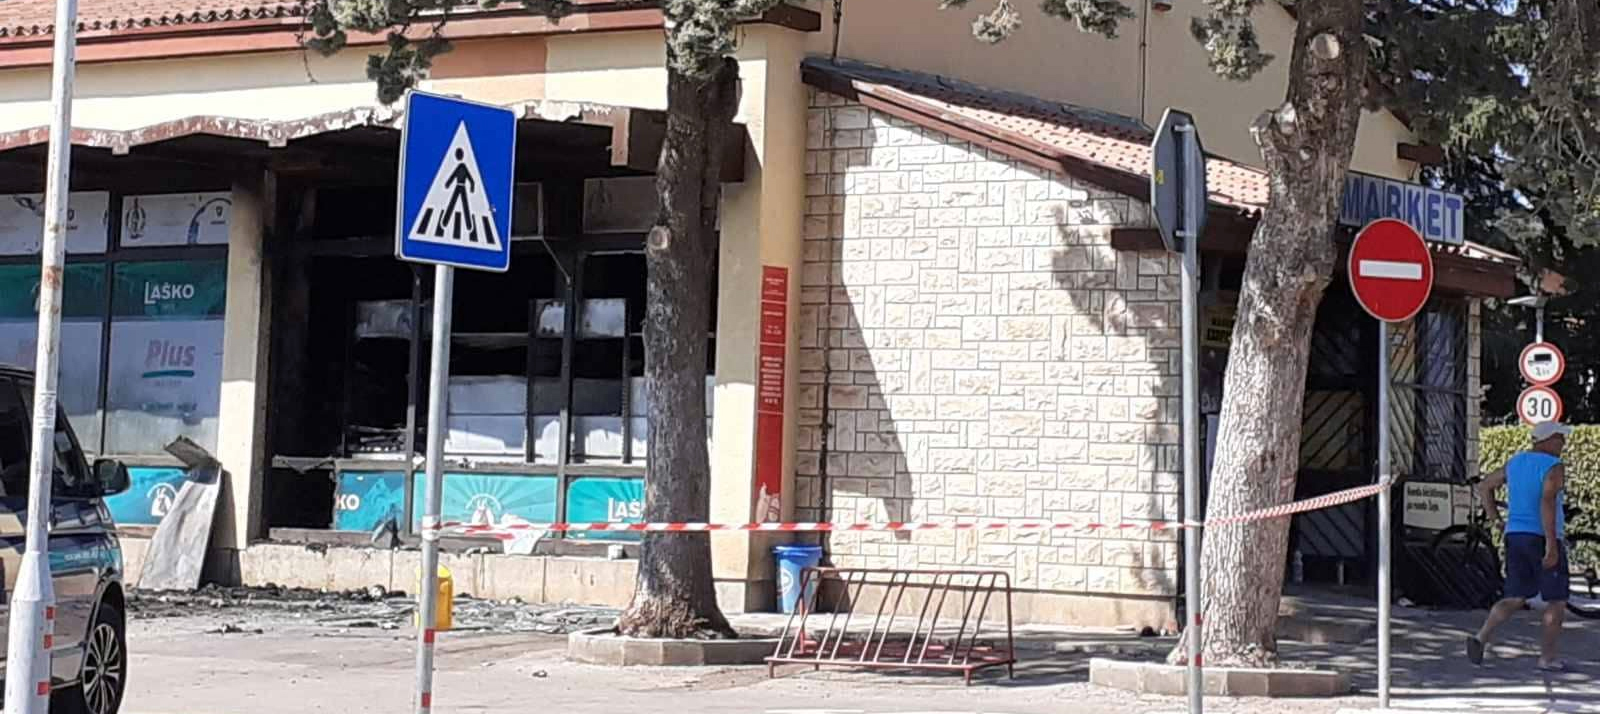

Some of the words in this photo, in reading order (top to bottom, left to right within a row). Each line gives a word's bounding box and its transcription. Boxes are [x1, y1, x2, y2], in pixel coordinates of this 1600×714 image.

[1342, 177, 1461, 239] MARKET
[144, 281, 195, 304] LAŠKO
[144, 340, 196, 368] Plus
[1527, 397, 1552, 418] 30
[607, 497, 643, 522] LAŠ
